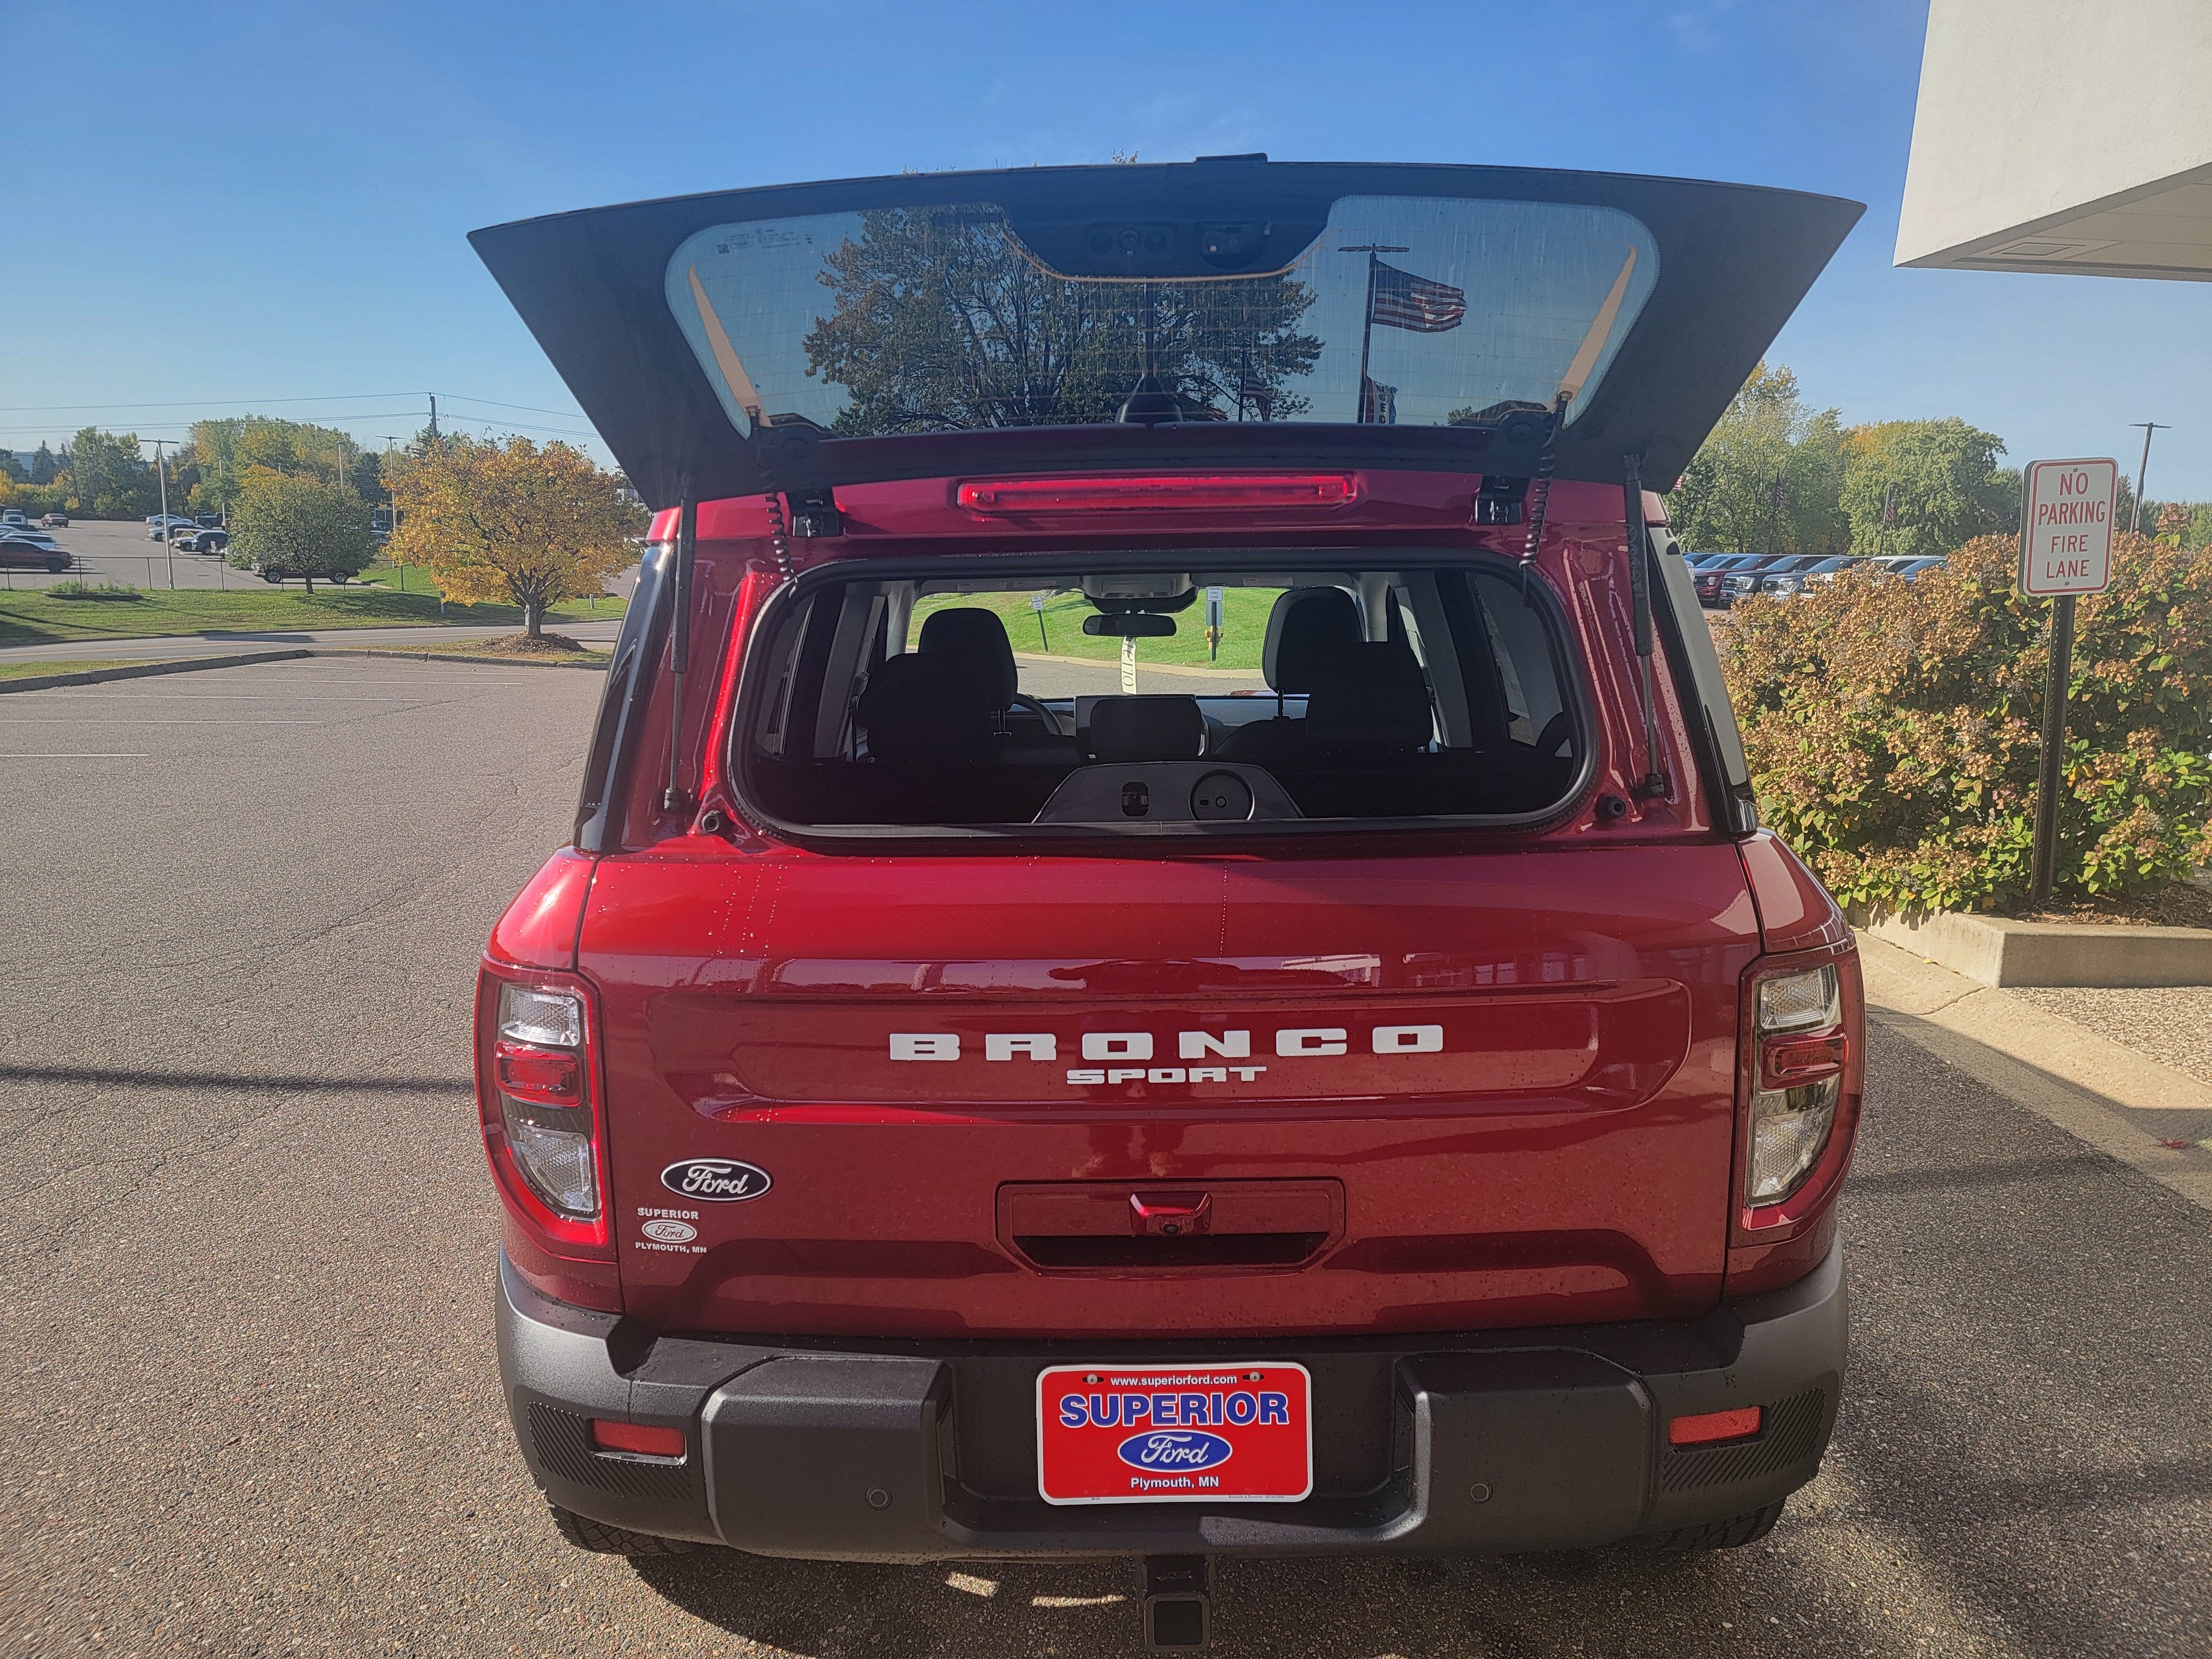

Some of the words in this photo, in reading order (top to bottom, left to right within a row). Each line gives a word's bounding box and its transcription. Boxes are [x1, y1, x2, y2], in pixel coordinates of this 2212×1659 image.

[2059, 472, 2089, 496] NO
[2038, 500, 2106, 526] PARKING
[2051, 534, 2089, 554] FIRE
[2046, 559, 2090, 579] LANE
[889, 1025, 1443, 1061] BRONCO
[1066, 1066, 1267, 1084] SPORT
[682, 1165, 749, 1194] Ford
[637, 1207, 699, 1220] SUPERIOR
[655, 1224, 685, 1239] Ford
[635, 1242, 690, 1254] PLYMOUTH,
[1110, 1374, 1238, 1387] www.superiorford.com
[1059, 1391, 1290, 1428] SUPERIOR
[1140, 1434, 1210, 1465] Ford
[1130, 1477, 1195, 1489] Plymouth,
[1198, 1477, 1220, 1488] MN
